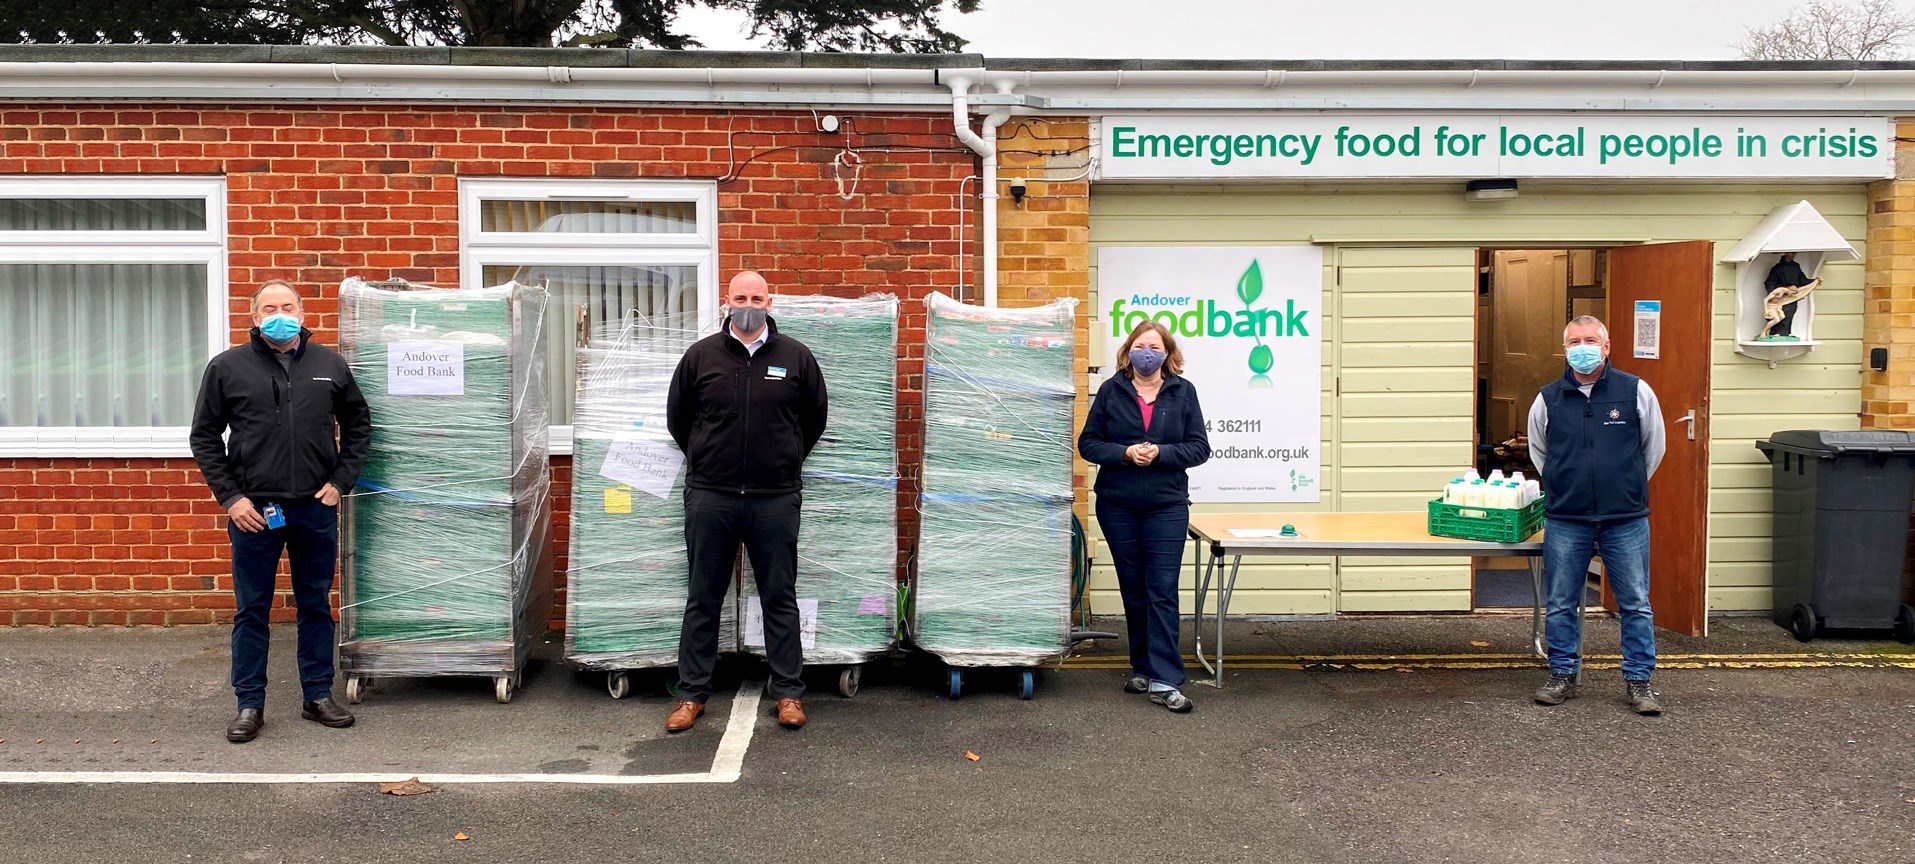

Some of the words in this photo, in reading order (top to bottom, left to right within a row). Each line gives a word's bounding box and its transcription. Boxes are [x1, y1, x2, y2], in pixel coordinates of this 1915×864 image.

[1111, 125, 1321, 167] Emergency
[1334, 125, 1421, 158] food
[1435, 125, 1487, 158] for
[1499, 126, 1585, 158] local
[1600, 127, 1723, 166] people
[1738, 127, 1767, 158] in
[1781, 127, 1879, 159] crisis
[1131, 294, 1191, 306] Andover
[402, 351, 449, 361] Andover
[396, 366, 424, 376] Food
[427, 366, 456, 377] Bank
[1217, 419, 1261, 433] 362111
[614, 452, 640, 468] Food
